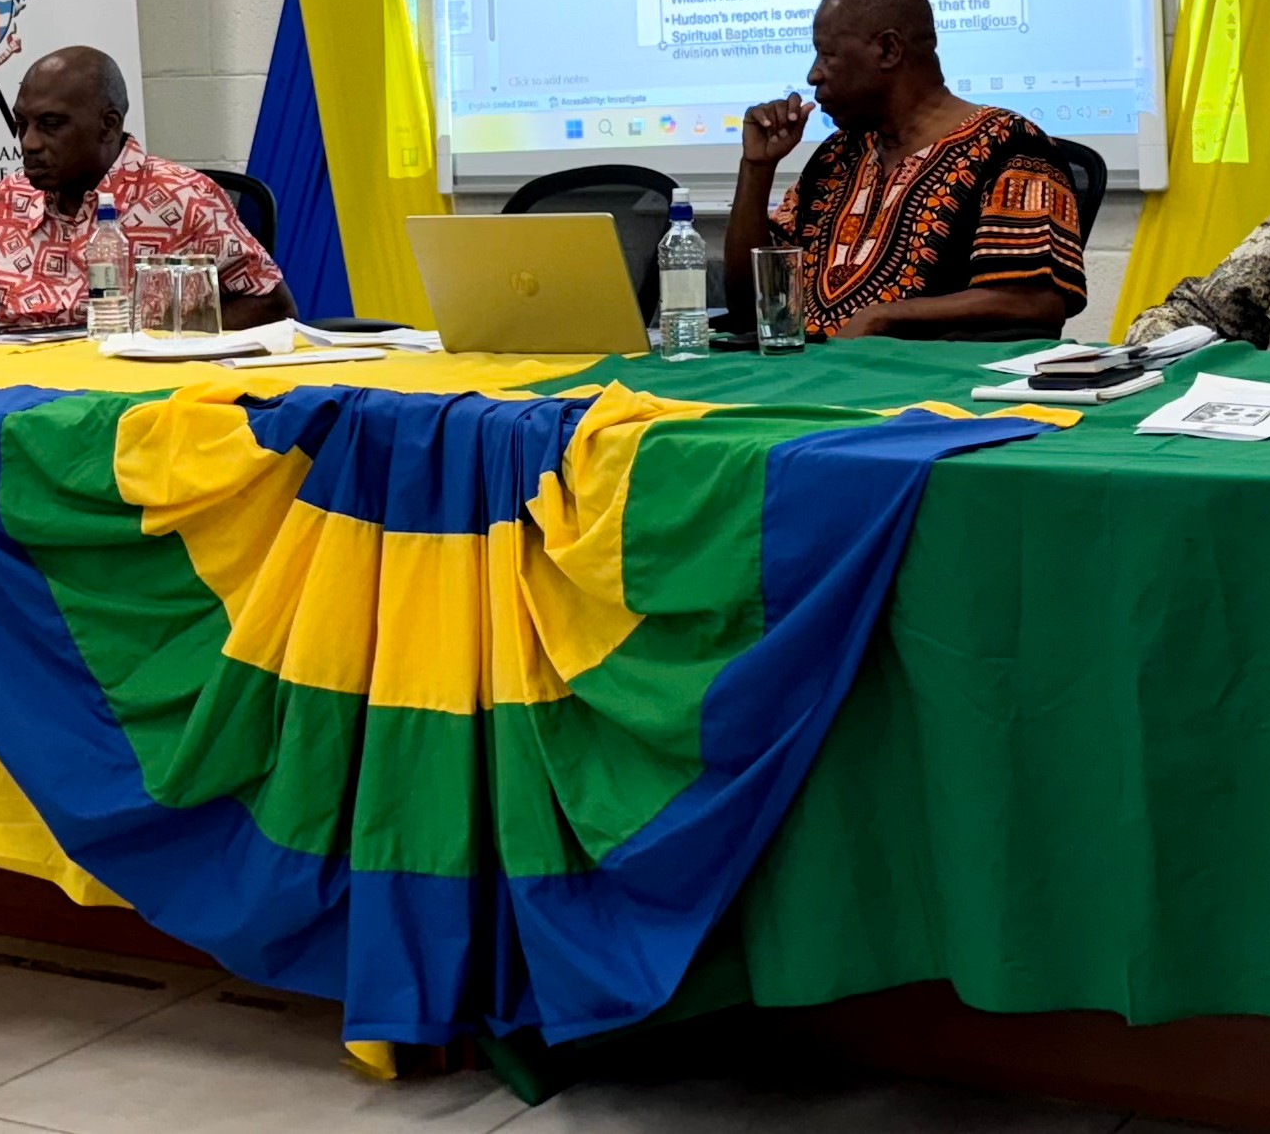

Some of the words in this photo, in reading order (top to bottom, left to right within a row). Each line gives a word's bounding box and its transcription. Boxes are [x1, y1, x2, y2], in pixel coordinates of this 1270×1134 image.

[731, 8, 768, 25] report
[771, 7, 781, 20] is
[784, 8, 818, 19] over
[671, 26, 722, 44] Spiritual
[725, 24, 775, 41] Baptists
[933, 19, 957, 29] ous
[959, 14, 1018, 30] religious
[672, 45, 718, 59] division
[720, 42, 758, 56] within
[760, 41, 782, 54] the
[784, 40, 814, 53] chur
[509, 77, 530, 87] Click
[532, 76, 542, 86] to
[564, 74, 589, 84] notes
